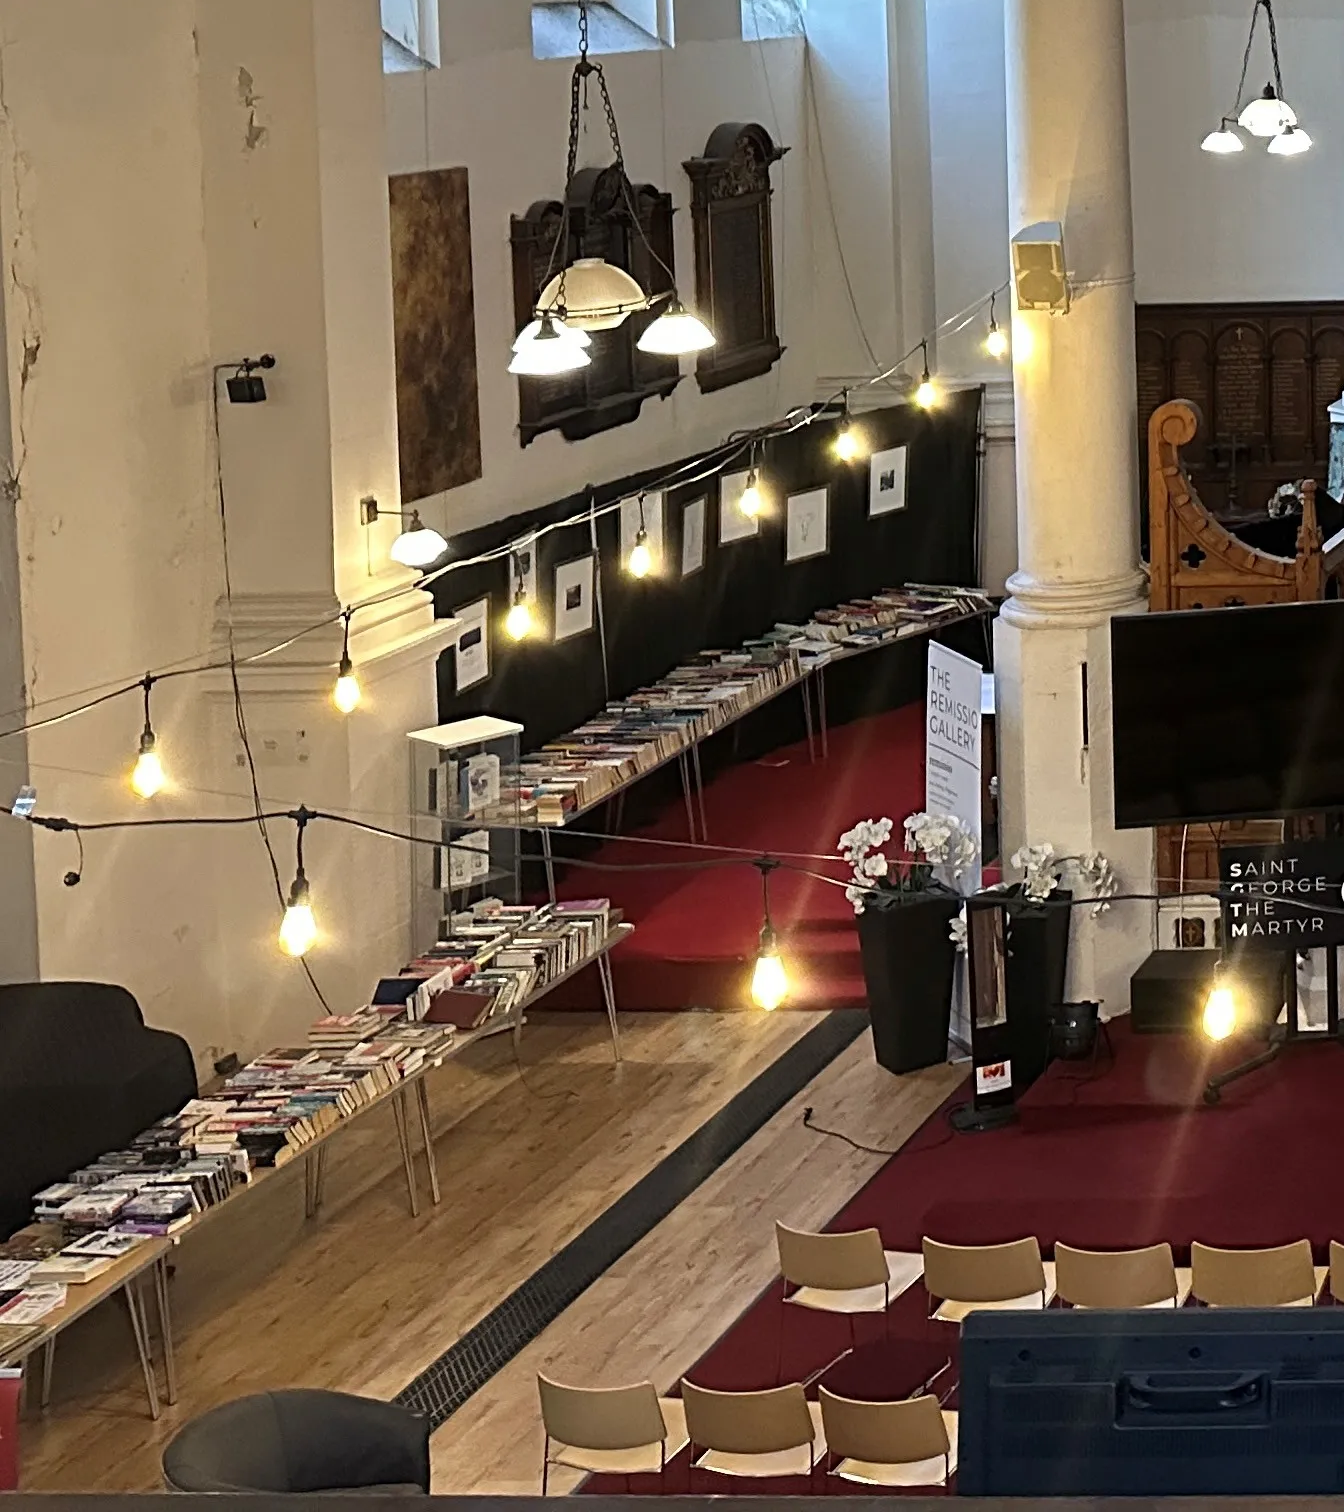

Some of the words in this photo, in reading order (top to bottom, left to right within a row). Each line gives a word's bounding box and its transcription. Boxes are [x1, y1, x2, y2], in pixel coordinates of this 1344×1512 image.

[929, 665, 951, 692] THE
[930, 689, 978, 730] REMISSIO
[929, 715, 976, 752] GALLERY
[1229, 858, 1299, 878] SAINT
[1229, 900, 1275, 918] THE
[1231, 917, 1324, 938] MARTYR
